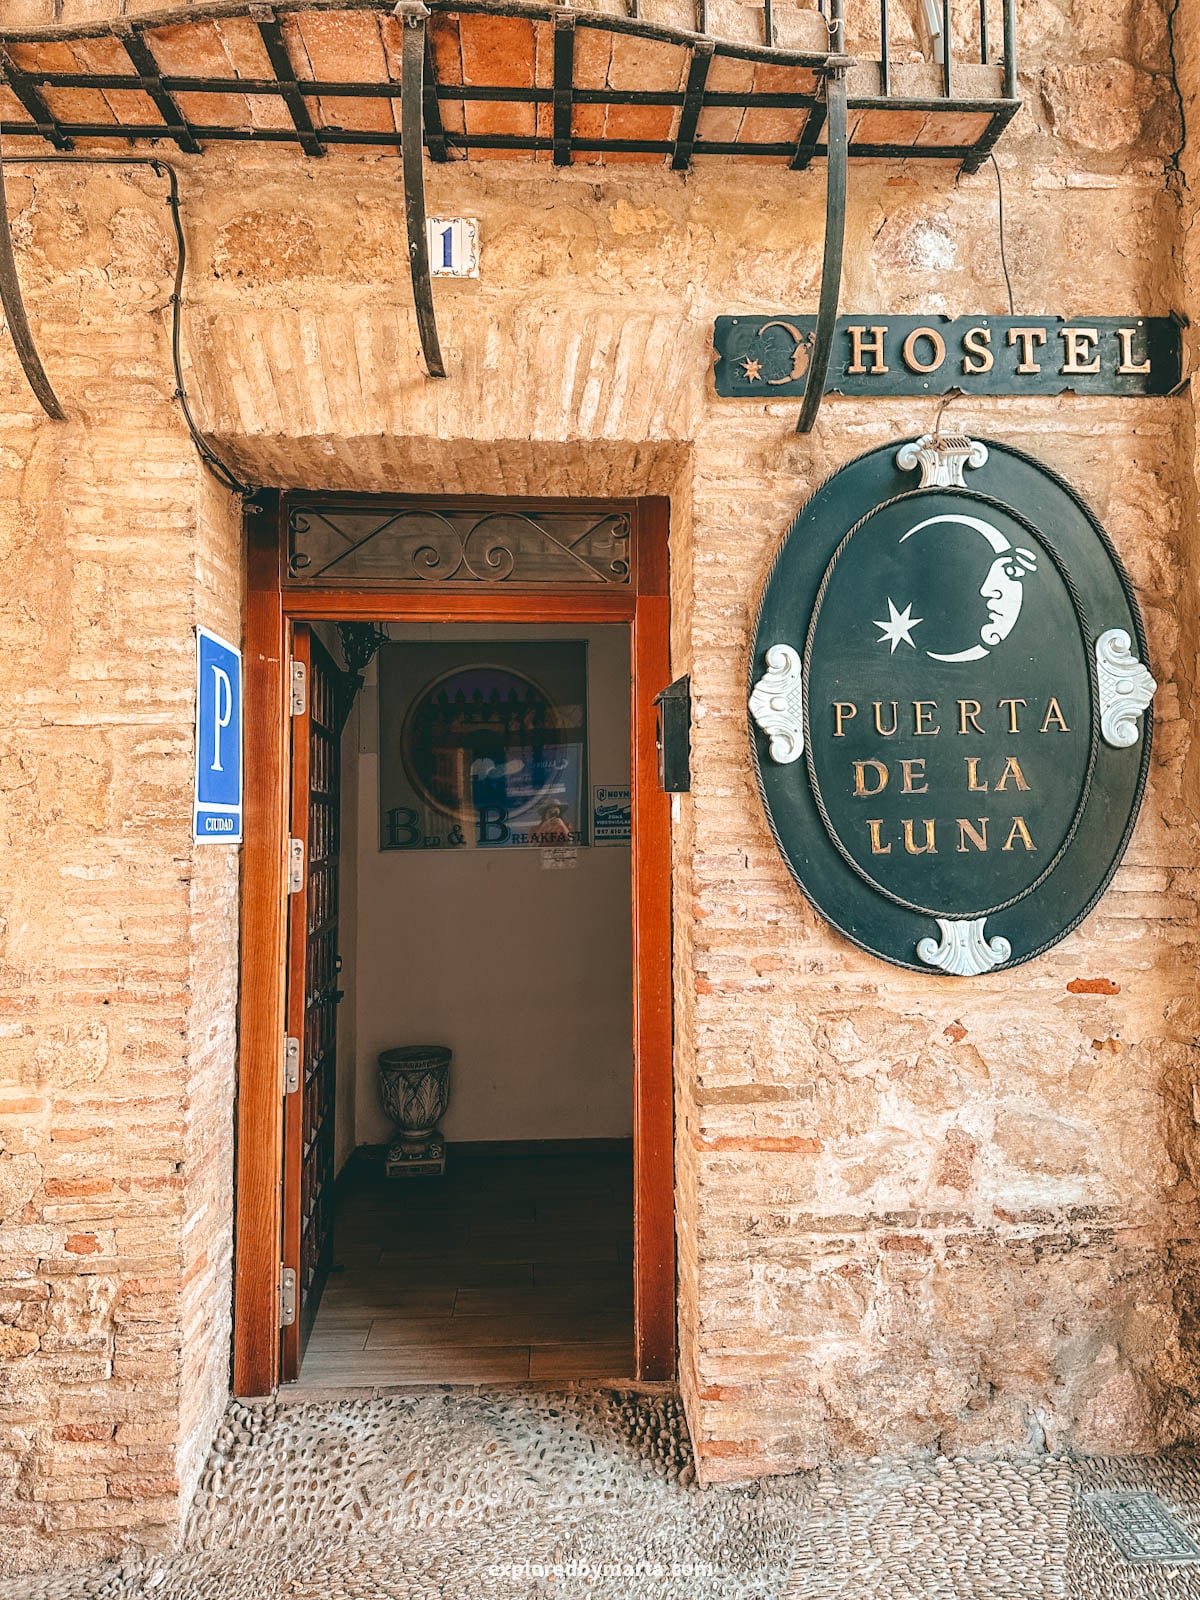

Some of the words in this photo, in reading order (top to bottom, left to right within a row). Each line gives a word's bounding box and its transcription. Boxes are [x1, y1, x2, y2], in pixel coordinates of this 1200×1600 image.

[440, 226, 453, 268] 1
[847, 326, 1151, 375] HOSTEL
[210, 664, 233, 772] P
[832, 697, 1071, 737] PUERTA
[851, 758, 929, 797] DE
[964, 756, 1032, 792] LA
[205, 817, 234, 832] CIUDAD
[447, 824, 467, 846] &
[865, 816, 1038, 855] LUNA
